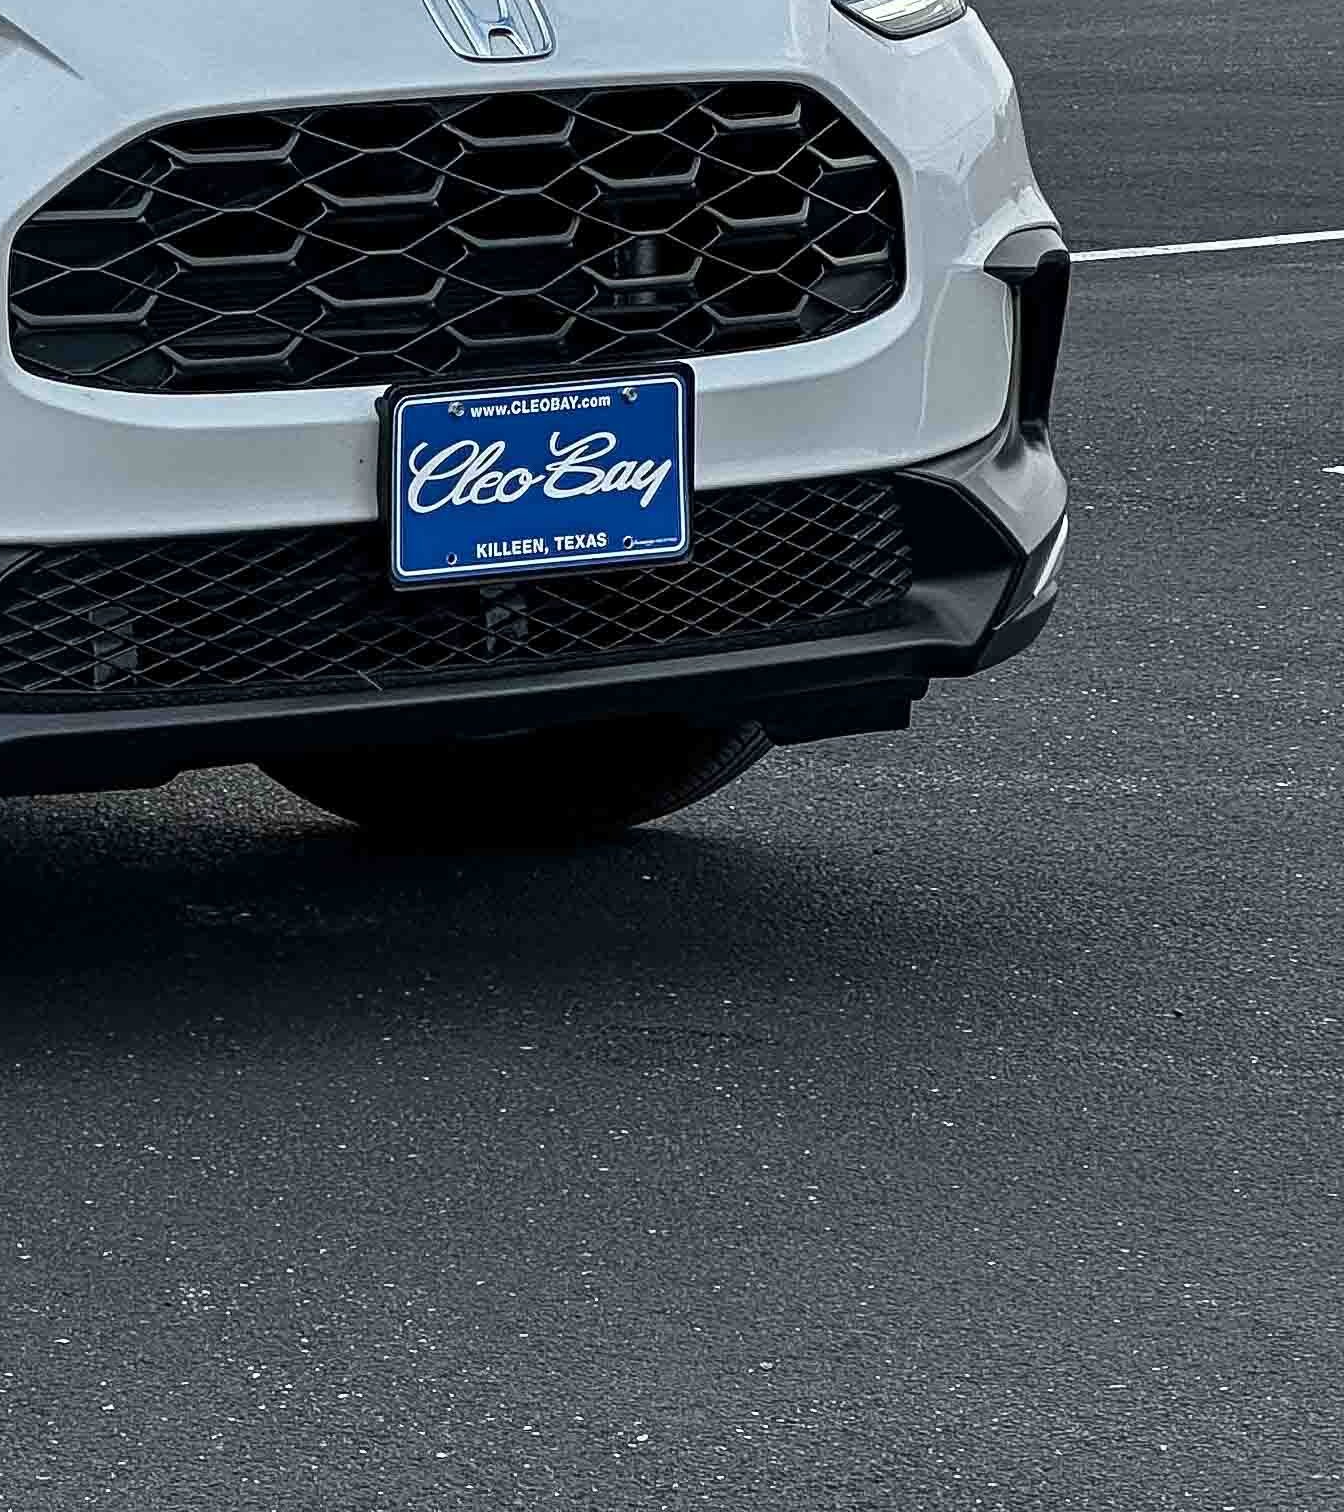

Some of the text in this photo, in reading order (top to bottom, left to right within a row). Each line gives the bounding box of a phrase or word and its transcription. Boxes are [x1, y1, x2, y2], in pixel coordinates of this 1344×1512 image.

[470, 394, 611, 418] www.CLEOBAY.com
[408, 431, 672, 514] Cleo Bay
[476, 536, 549, 559] KILLEEN,
[554, 532, 608, 552] TEXAS
